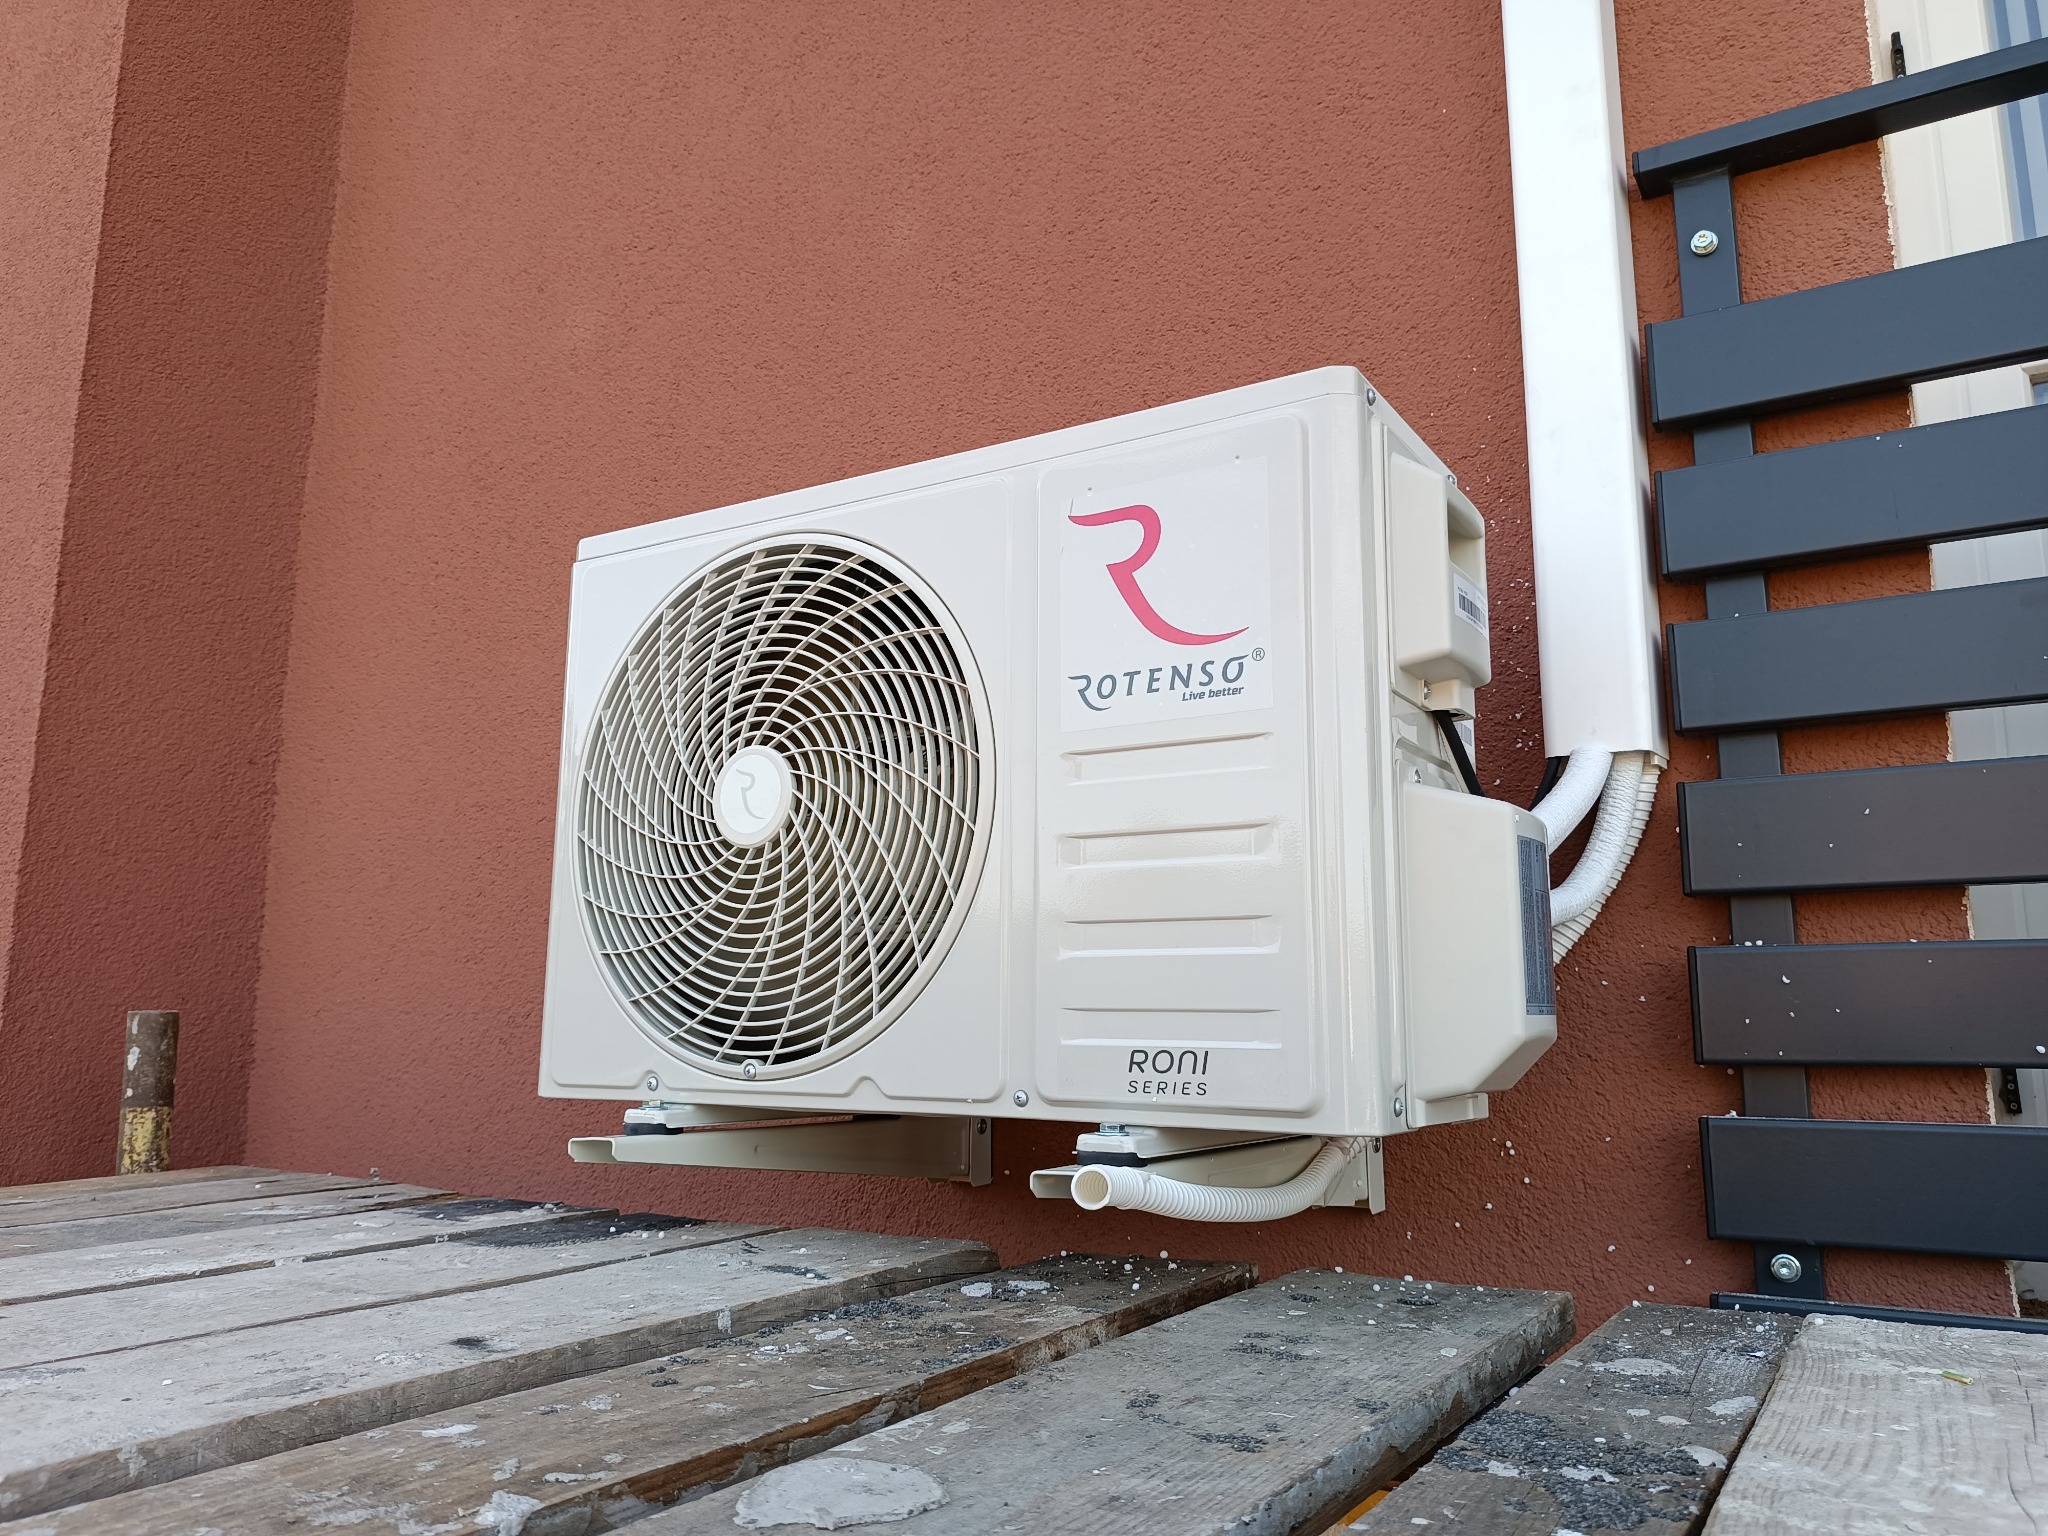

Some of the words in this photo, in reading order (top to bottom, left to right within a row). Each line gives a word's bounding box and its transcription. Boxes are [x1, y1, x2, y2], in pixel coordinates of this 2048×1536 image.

[1181, 690, 1206, 702] Live
[1207, 686, 1244, 698] better
[1128, 1049, 1209, 1075] RONI
[1127, 1080, 1207, 1096] SERIES
